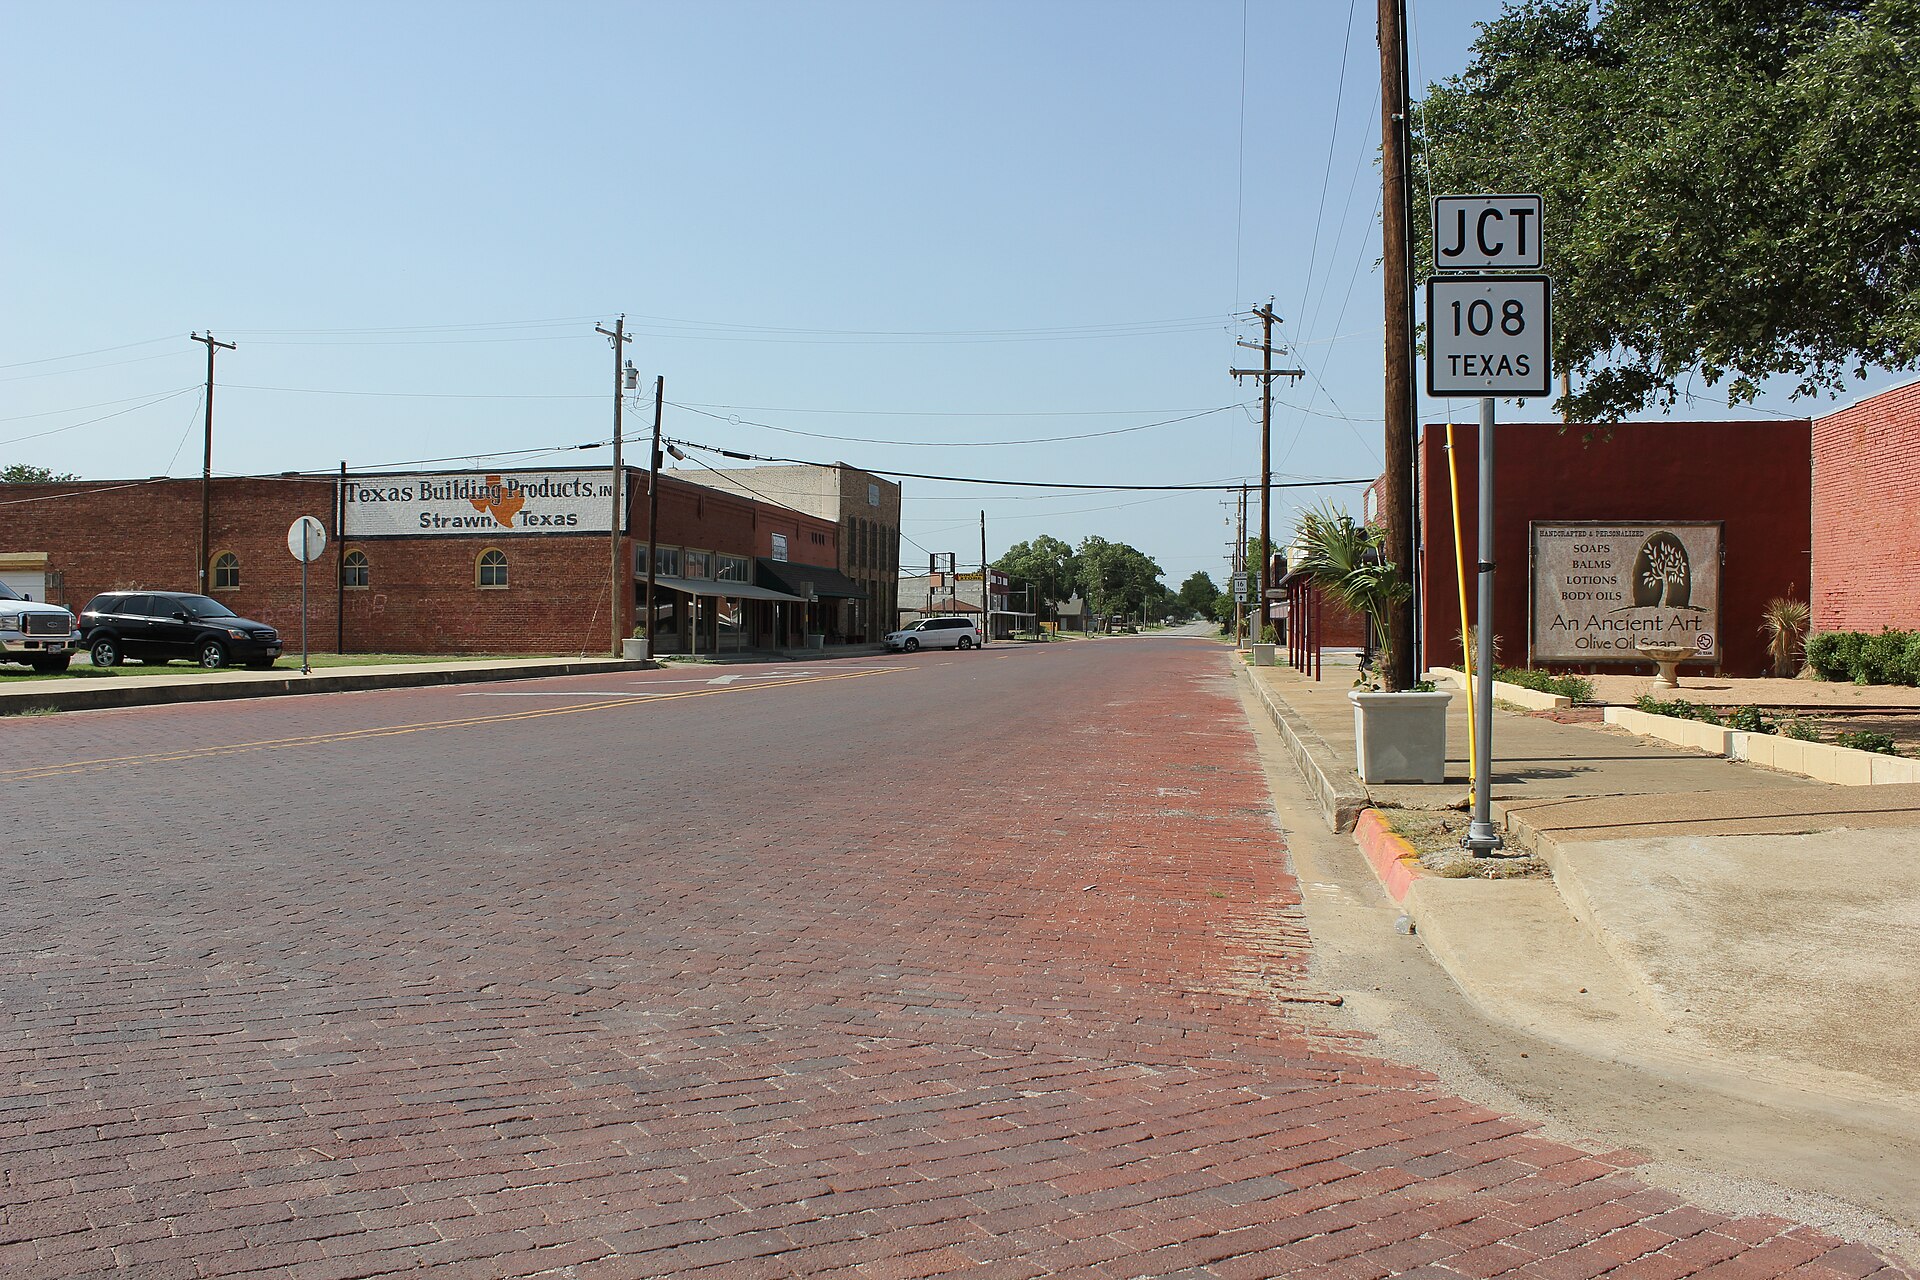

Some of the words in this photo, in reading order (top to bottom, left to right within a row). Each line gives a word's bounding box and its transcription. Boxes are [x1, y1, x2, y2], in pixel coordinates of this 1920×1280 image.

[1441, 208, 1534, 257] JCT
[1451, 299, 1525, 336] 108
[1448, 354, 1530, 376] TEXAS
[344, 483, 413, 502] Texas
[418, 479, 502, 505] Building
[506, 477, 597, 498] Products,
[600, 485, 625, 497] IN.
[420, 512, 499, 529] Strawn,
[520, 511, 578, 526] Texas
[1573, 544, 1610, 553] SOAPS
[1572, 560, 1611, 569] BALMS
[1566, 576, 1617, 585] LOTIONS
[1561, 592, 1593, 601] BODY
[1595, 592, 1622, 601] OILS
[1550, 614, 1579, 631] An
[1584, 614, 1663, 631] Ancient
[1667, 614, 1702, 631] Art
[1575, 633, 1612, 649] Olive
[1614, 633, 1635, 649] Oil
